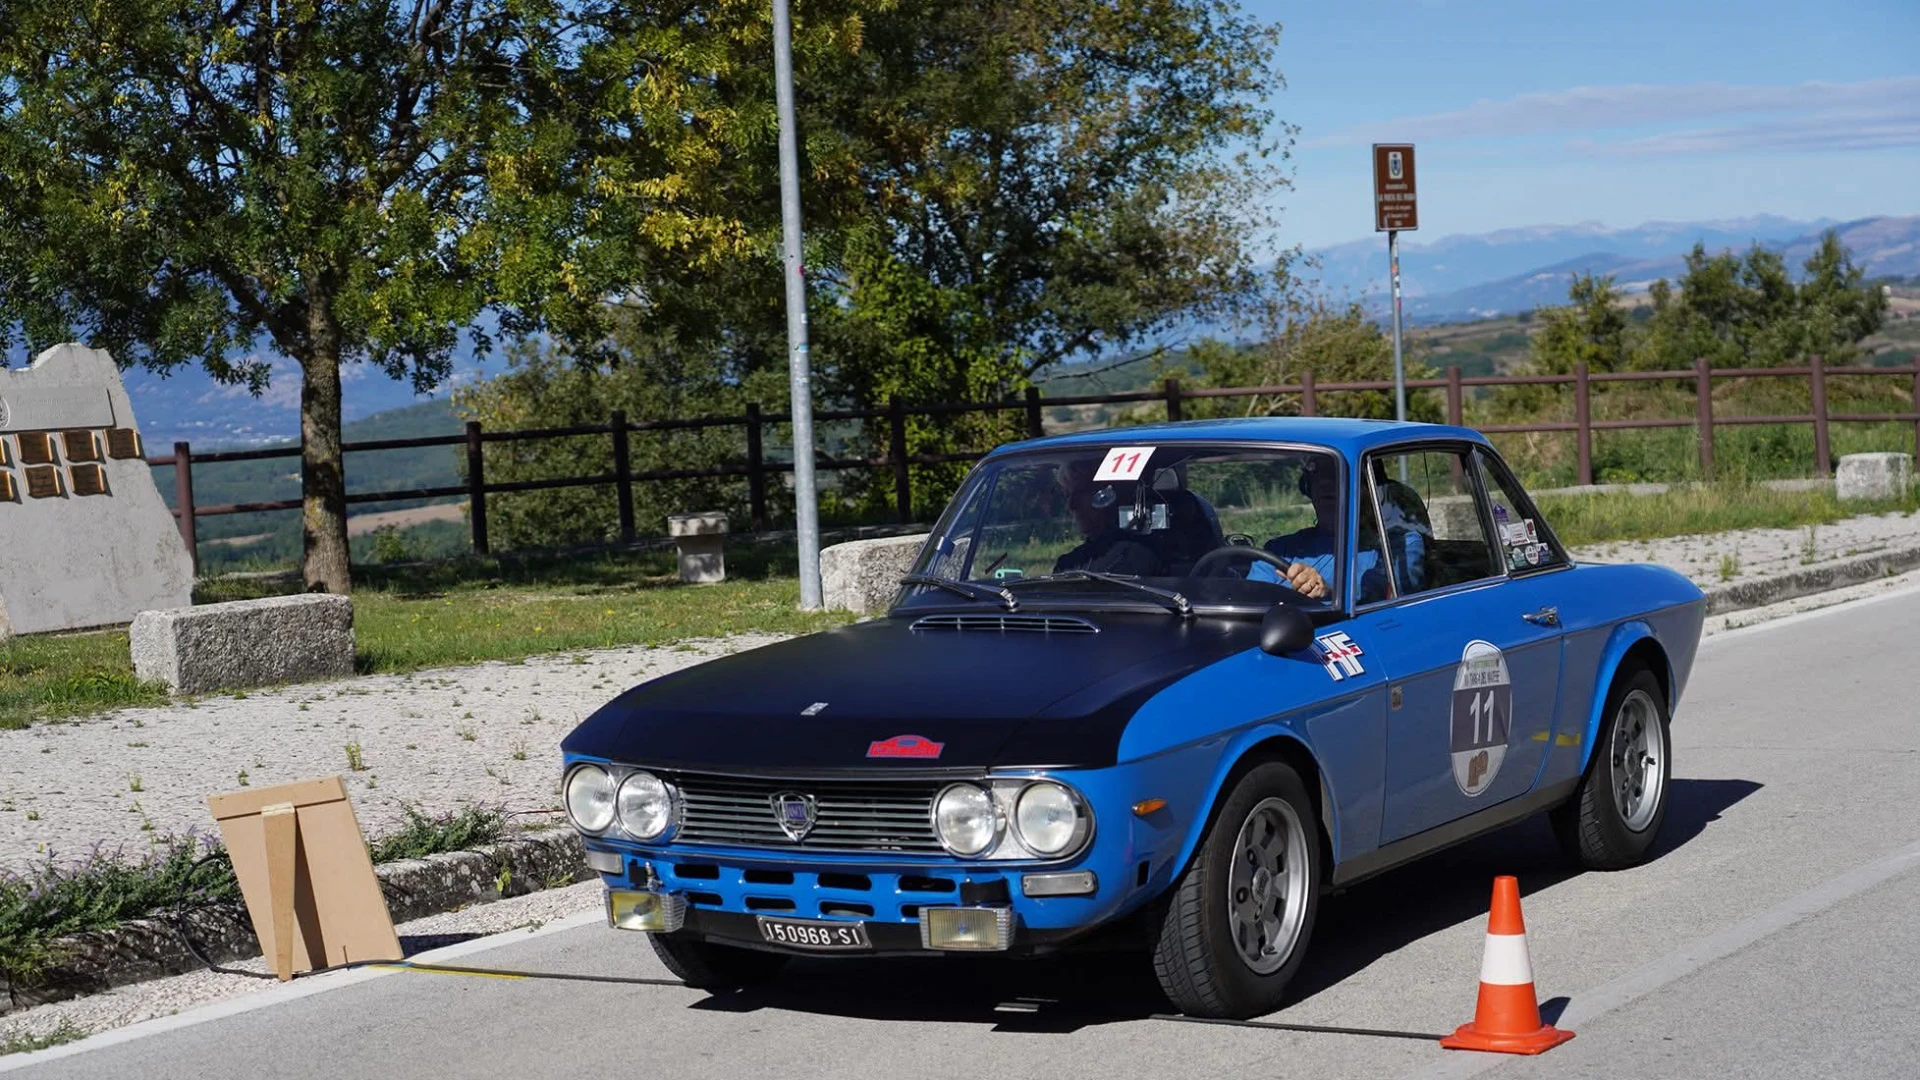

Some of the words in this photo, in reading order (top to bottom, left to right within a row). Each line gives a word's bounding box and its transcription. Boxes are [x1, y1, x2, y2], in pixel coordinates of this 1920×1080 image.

[1111, 452, 1142, 473] 11
[1469, 690, 1495, 744] 11
[766, 922, 831, 945] 150968
